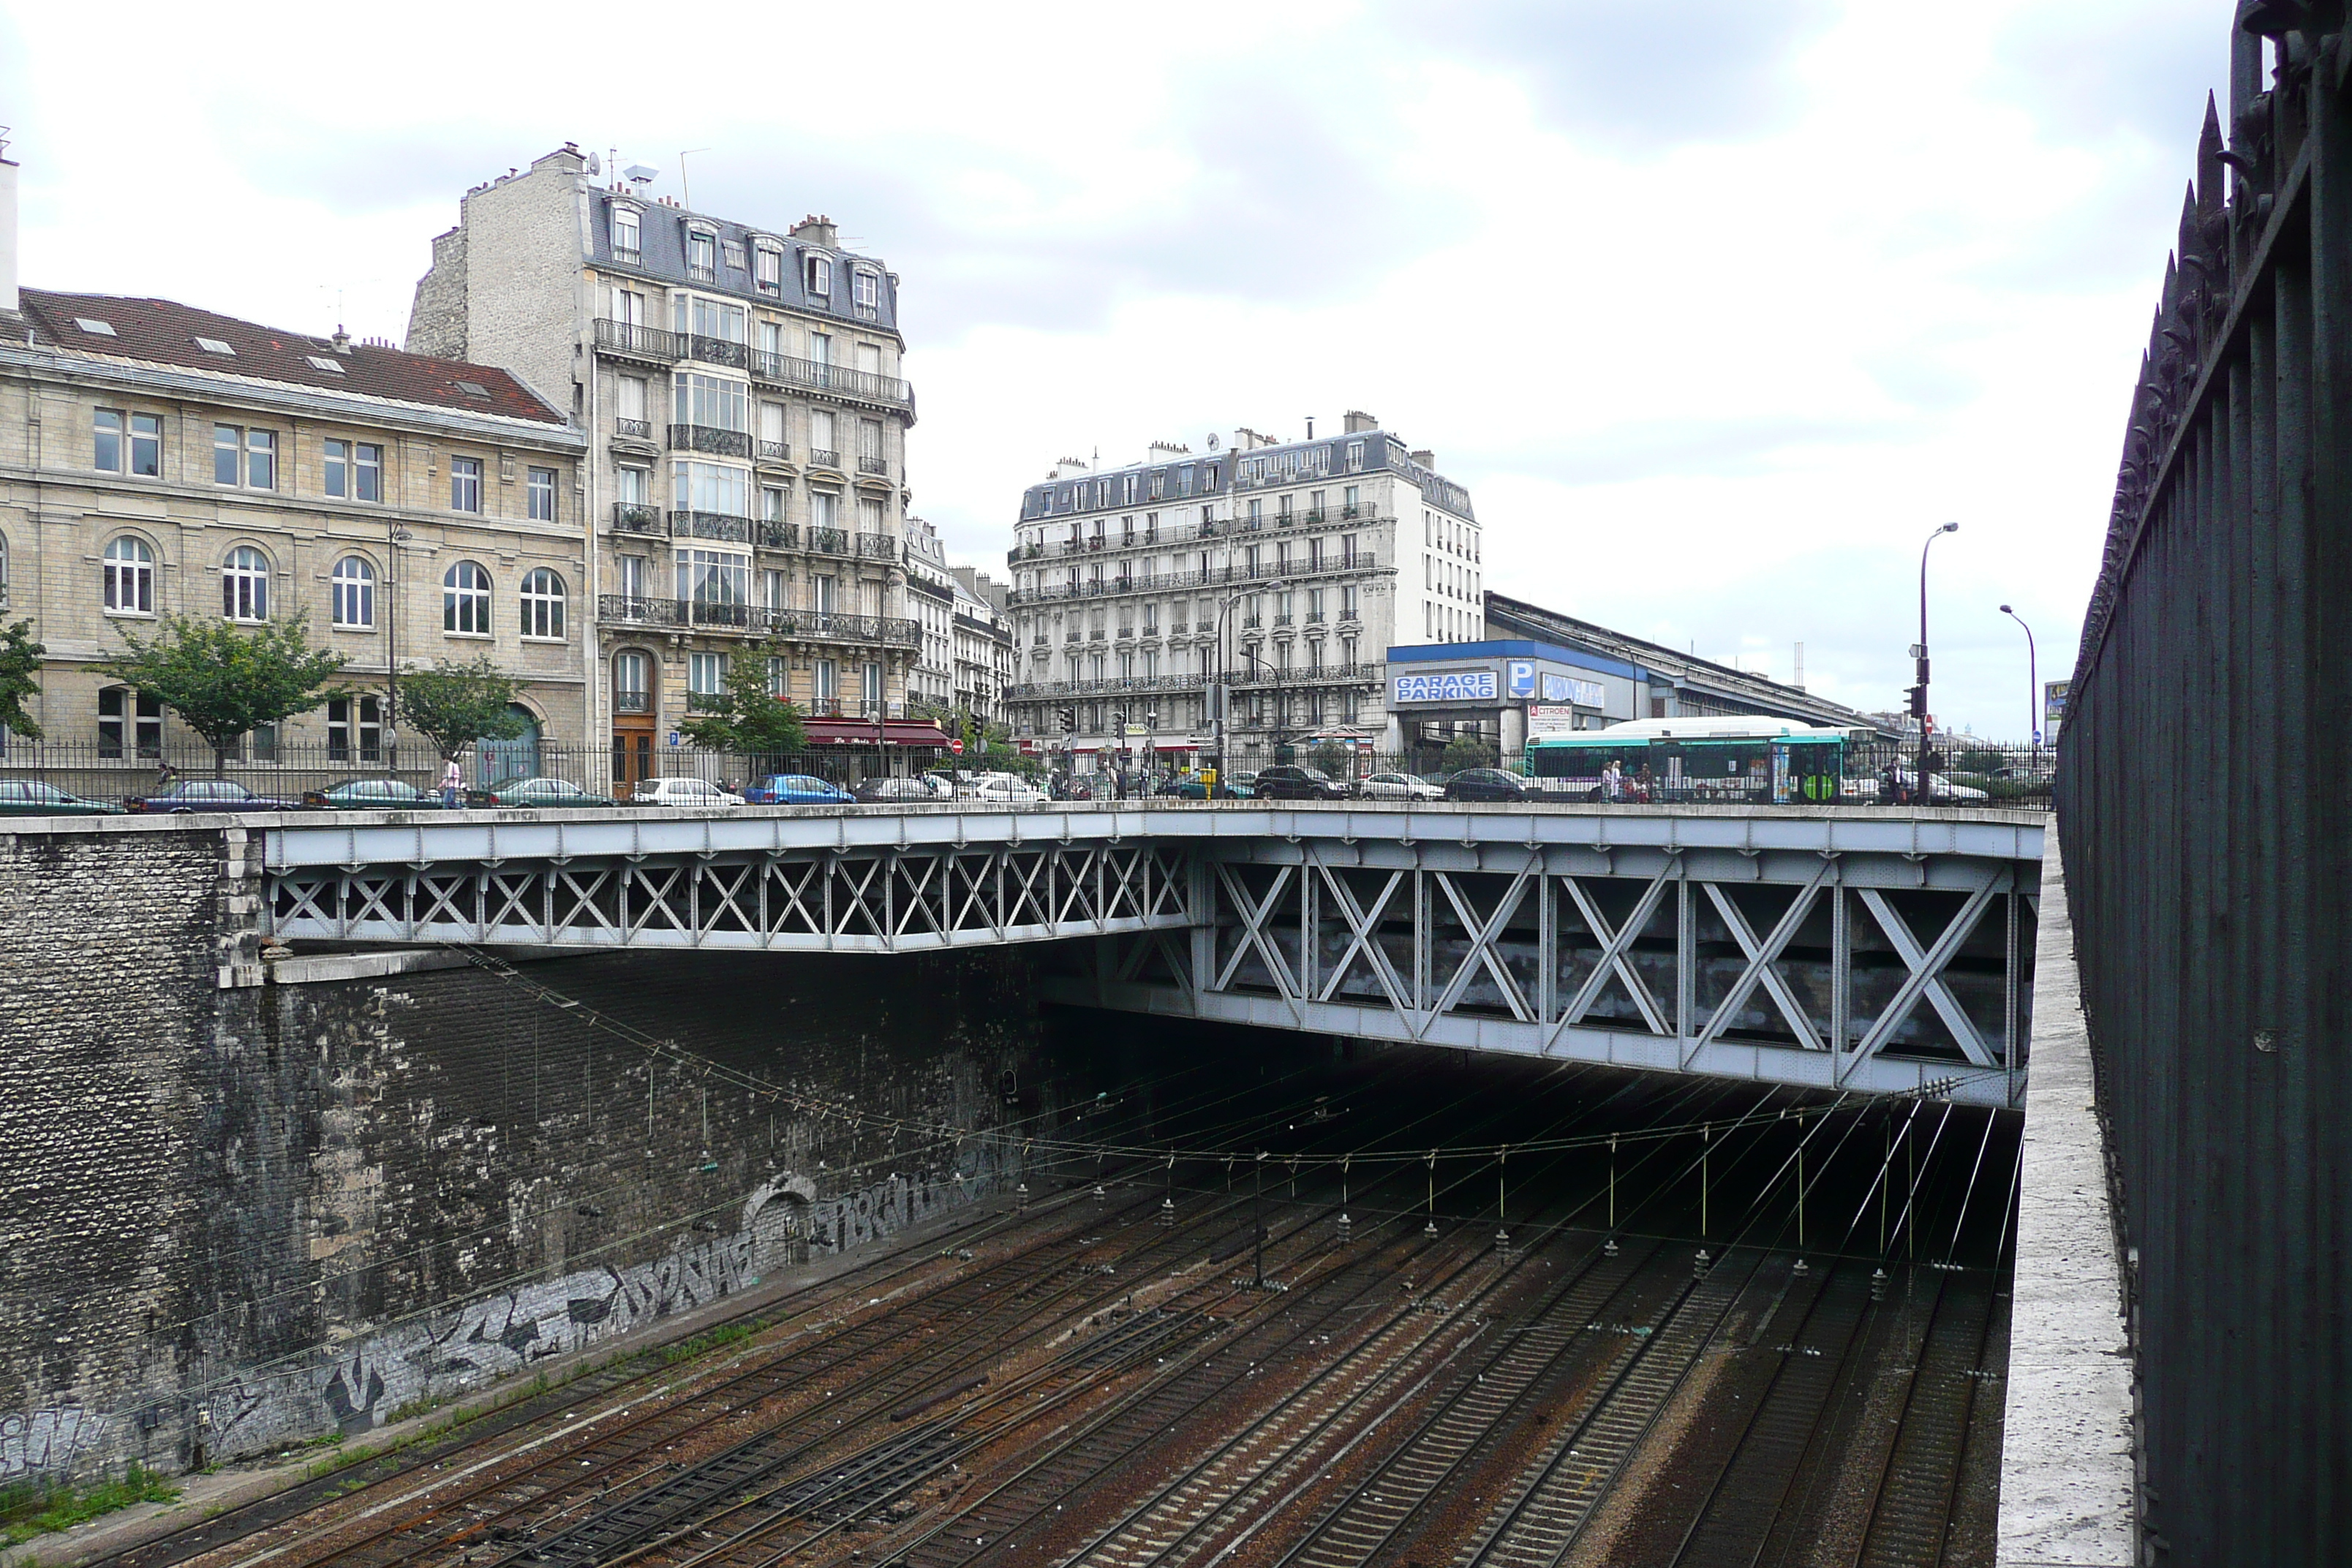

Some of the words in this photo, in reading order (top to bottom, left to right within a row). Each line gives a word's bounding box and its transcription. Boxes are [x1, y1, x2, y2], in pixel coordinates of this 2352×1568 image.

[1396, 674, 1493, 689] GARAGE
[1511, 663, 1533, 687] P
[1398, 686, 1493, 701] PARKING
[1544, 674, 1581, 704] PARKING
